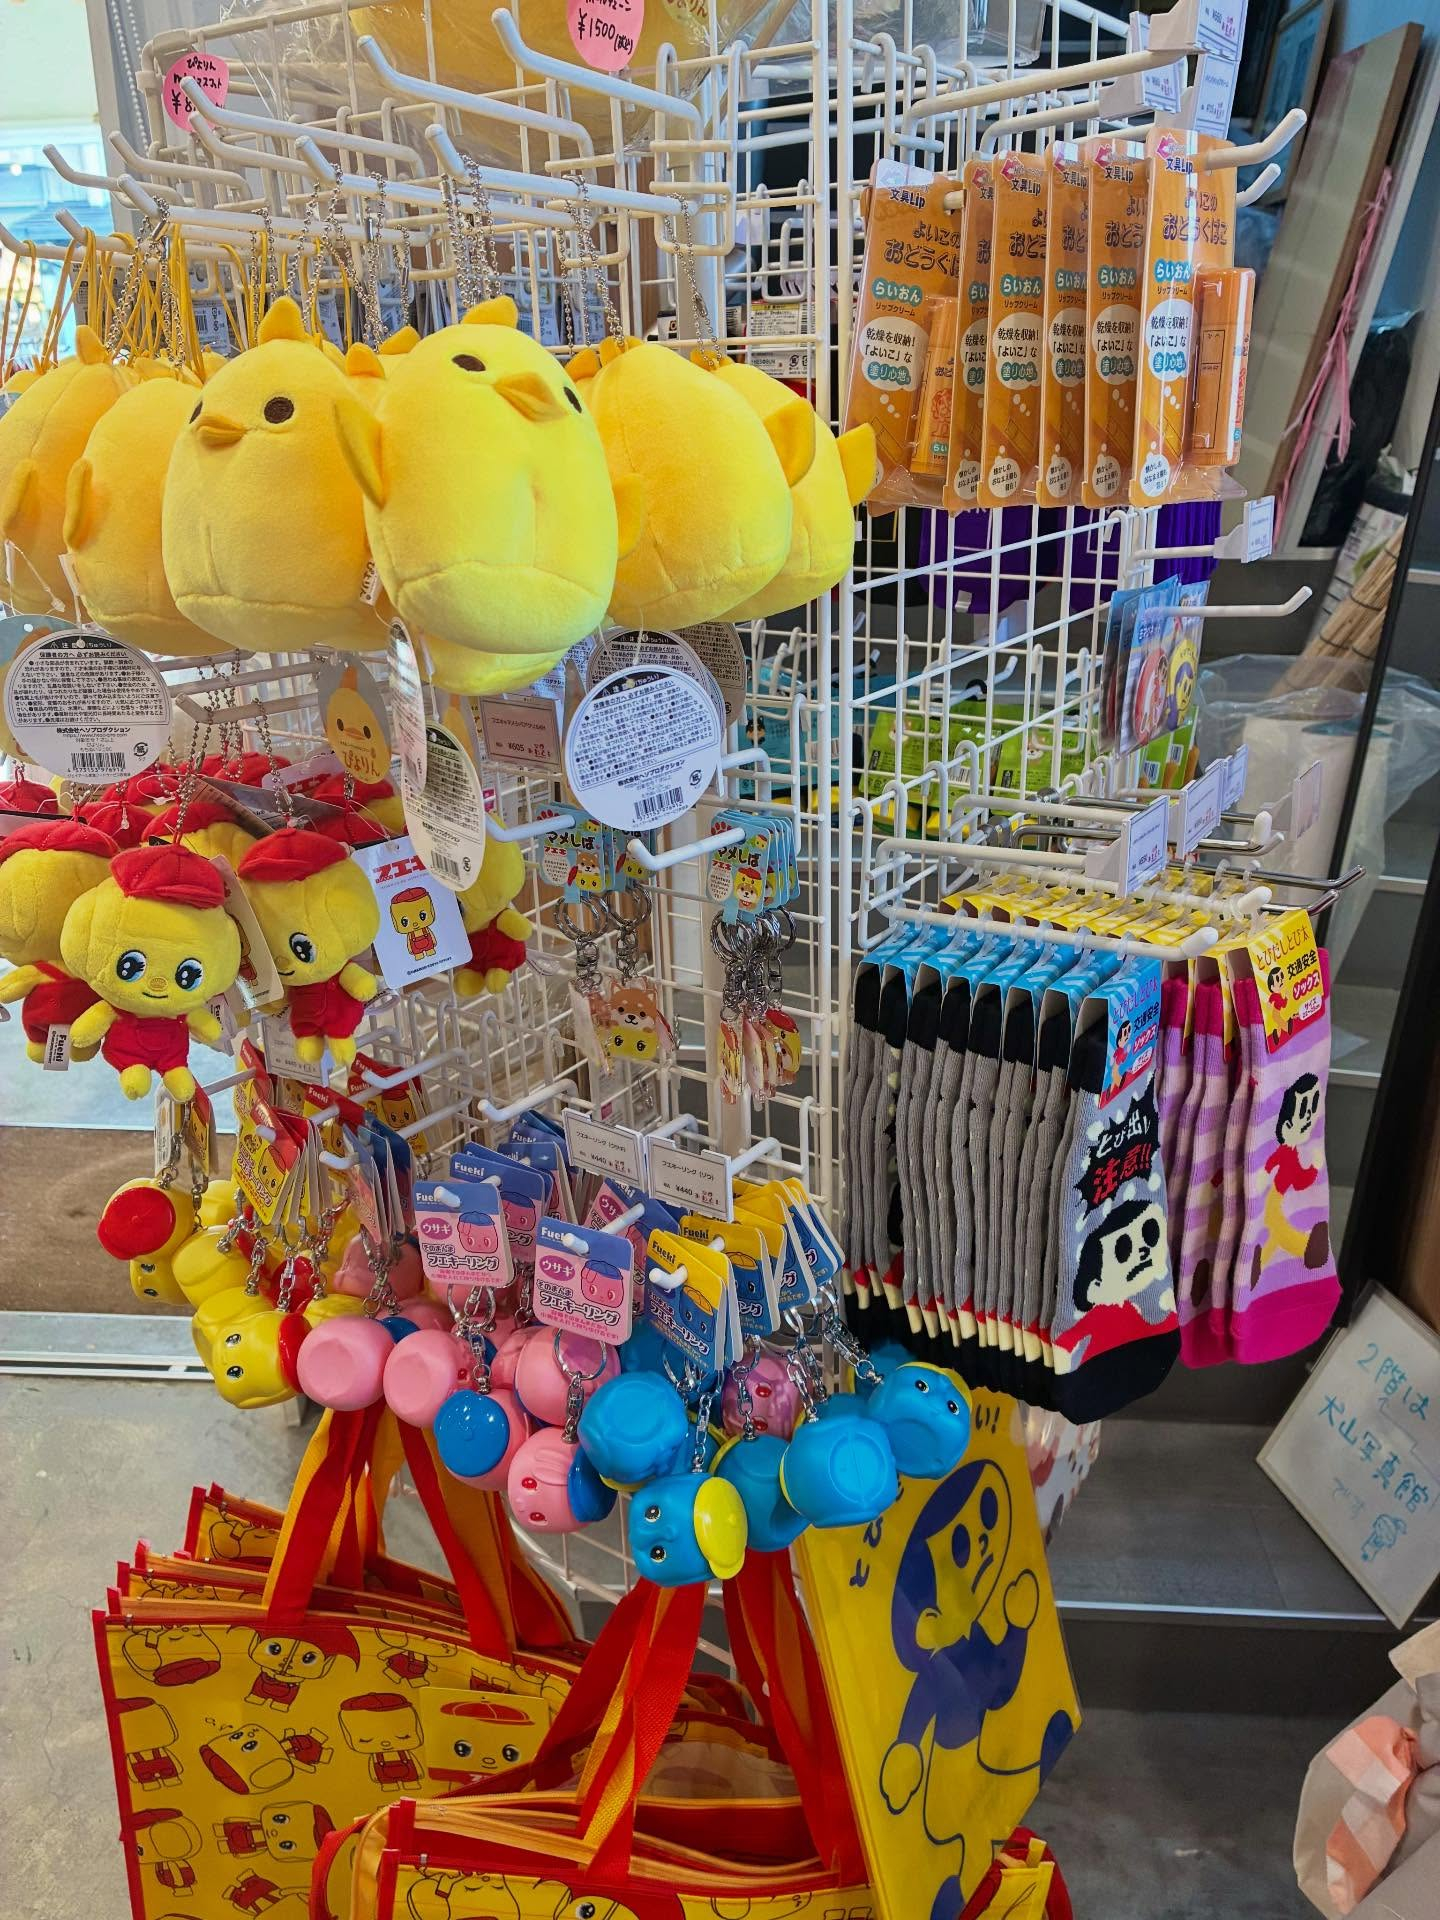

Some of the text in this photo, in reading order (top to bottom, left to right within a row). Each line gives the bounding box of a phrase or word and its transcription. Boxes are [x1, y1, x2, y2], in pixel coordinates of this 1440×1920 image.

[187, 56, 216, 71] ぴよりん
[1105, 166, 1134, 184] 文具Lip
[1166, 158, 1193, 175] 文具Lip
[1011, 178, 1041, 196] 文具Lip
[890, 188, 926, 209] 文具Lip
[1100, 267, 1135, 285] らいおん
[1155, 261, 1191, 280] らいおん
[1003, 279, 1041, 294] らいおん
[1056, 272, 1087, 288] らいおん
[875, 281, 920, 303] らいおん
[1103, 291, 1133, 300] リップクリーム
[875, 302, 916, 316] リップクリーム
[1004, 301, 1038, 309] リップクリーム
[1097, 321, 1135, 334] 乾燥を収納!
[1151, 315, 1189, 330] 乾燥を収納!
[866, 327, 915, 347] 乾燥を収納!
[998, 327, 1039, 342] 乾燥を収納!
[342, 750, 380, 777] ぴよりん
[545, 831, 596, 850] マメしば
[717, 846, 761, 868] マメしば
[1286, 949, 1318, 980] 交通安全
[1293, 972, 1320, 999] ソックス
[1133, 1001, 1160, 1033] 交通安全
[1097, 1109, 1150, 1158] とび出し
[454, 1162, 485, 1177] Fueki
[1093, 1142, 1152, 1205] 注意!!
[675, 1184, 694, 1196] ¥440
[422, 1223, 451, 1235] ウサギ
[683, 1227, 709, 1240] Fueki
[422, 1242, 455, 1254] そのまんま
[652, 1240, 676, 1264] Fueki
[427, 1253, 500, 1271] フエキーリング
[542, 1260, 574, 1277] ウサギ
[536, 1279, 574, 1299] そのまんま
[541, 1292, 620, 1326] フエキーリング
[650, 1301, 709, 1355] フエキーリング
[1357, 1342, 1430, 1421] 2階は
